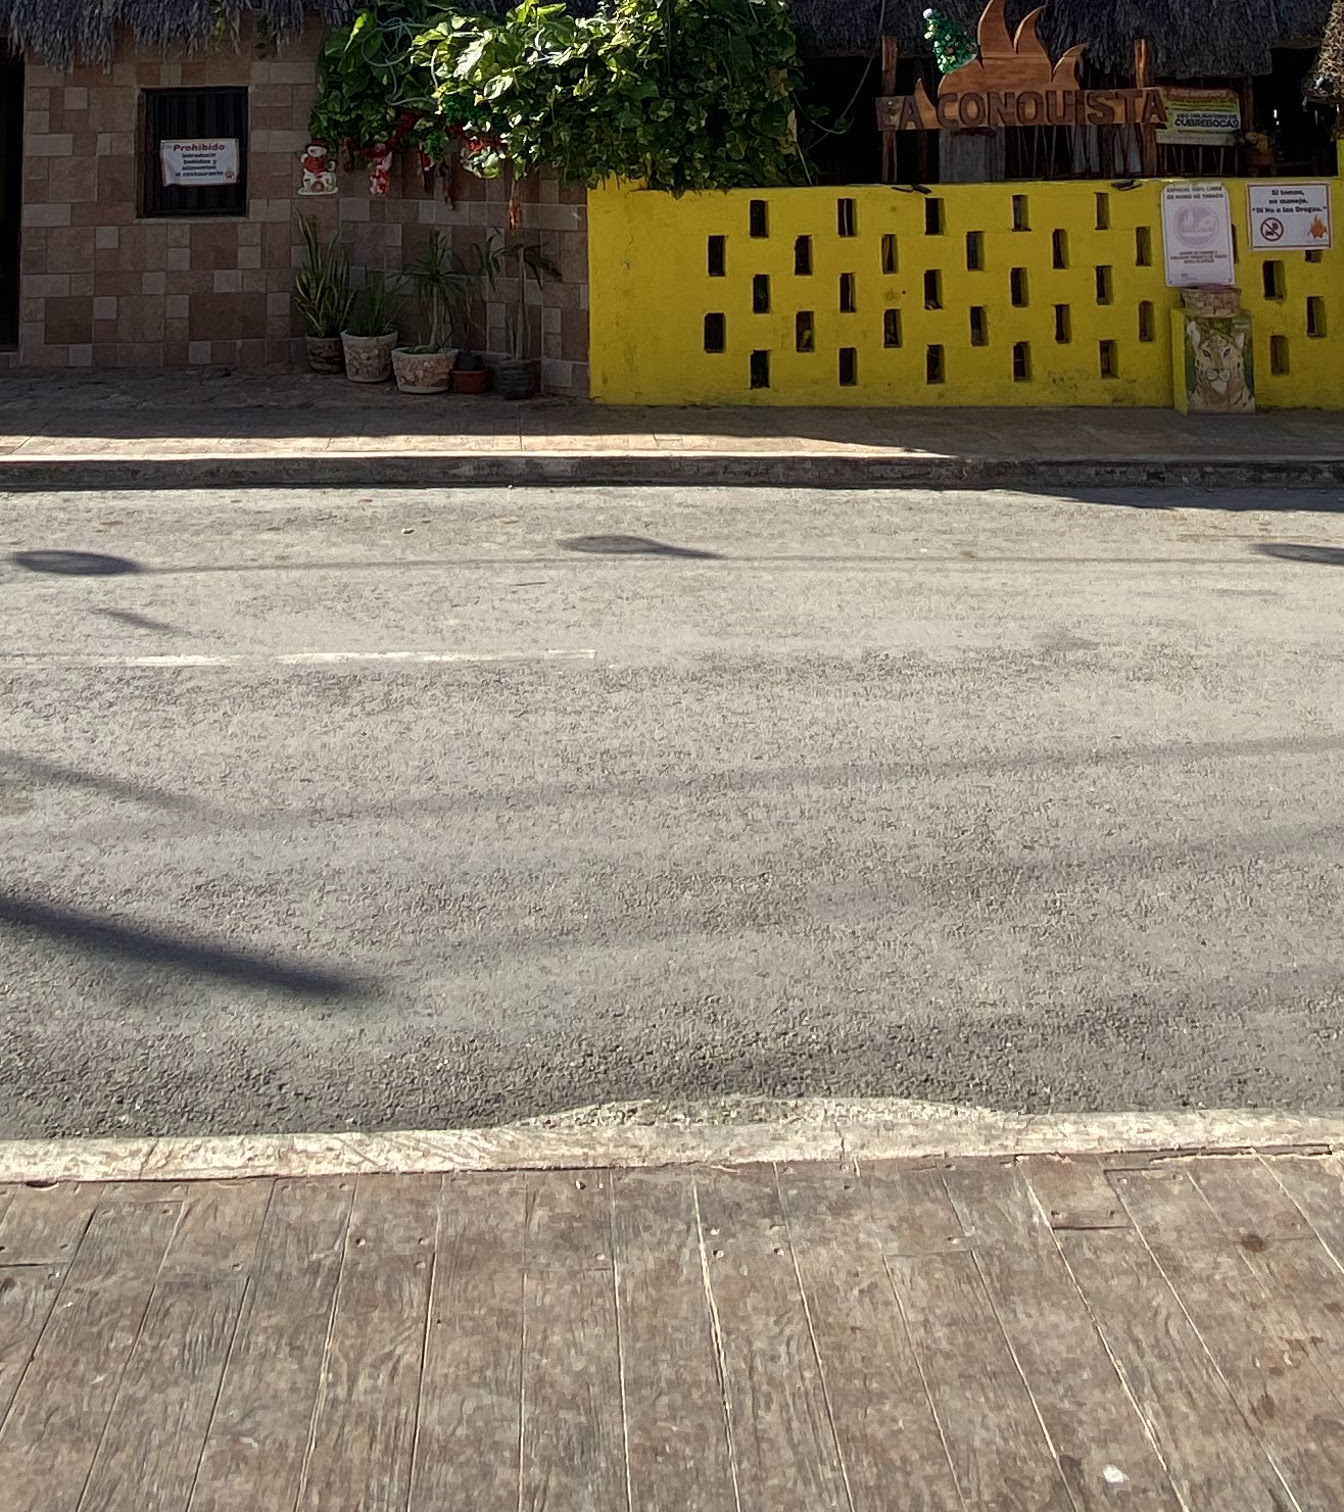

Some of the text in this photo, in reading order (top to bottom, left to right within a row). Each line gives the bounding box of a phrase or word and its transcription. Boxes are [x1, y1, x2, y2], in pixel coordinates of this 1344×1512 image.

[875, 88, 1168, 130] LA CONQUISTA
[1175, 119, 1239, 128] CUBREBOCAS
[173, 143, 225, 152] Prohibido
